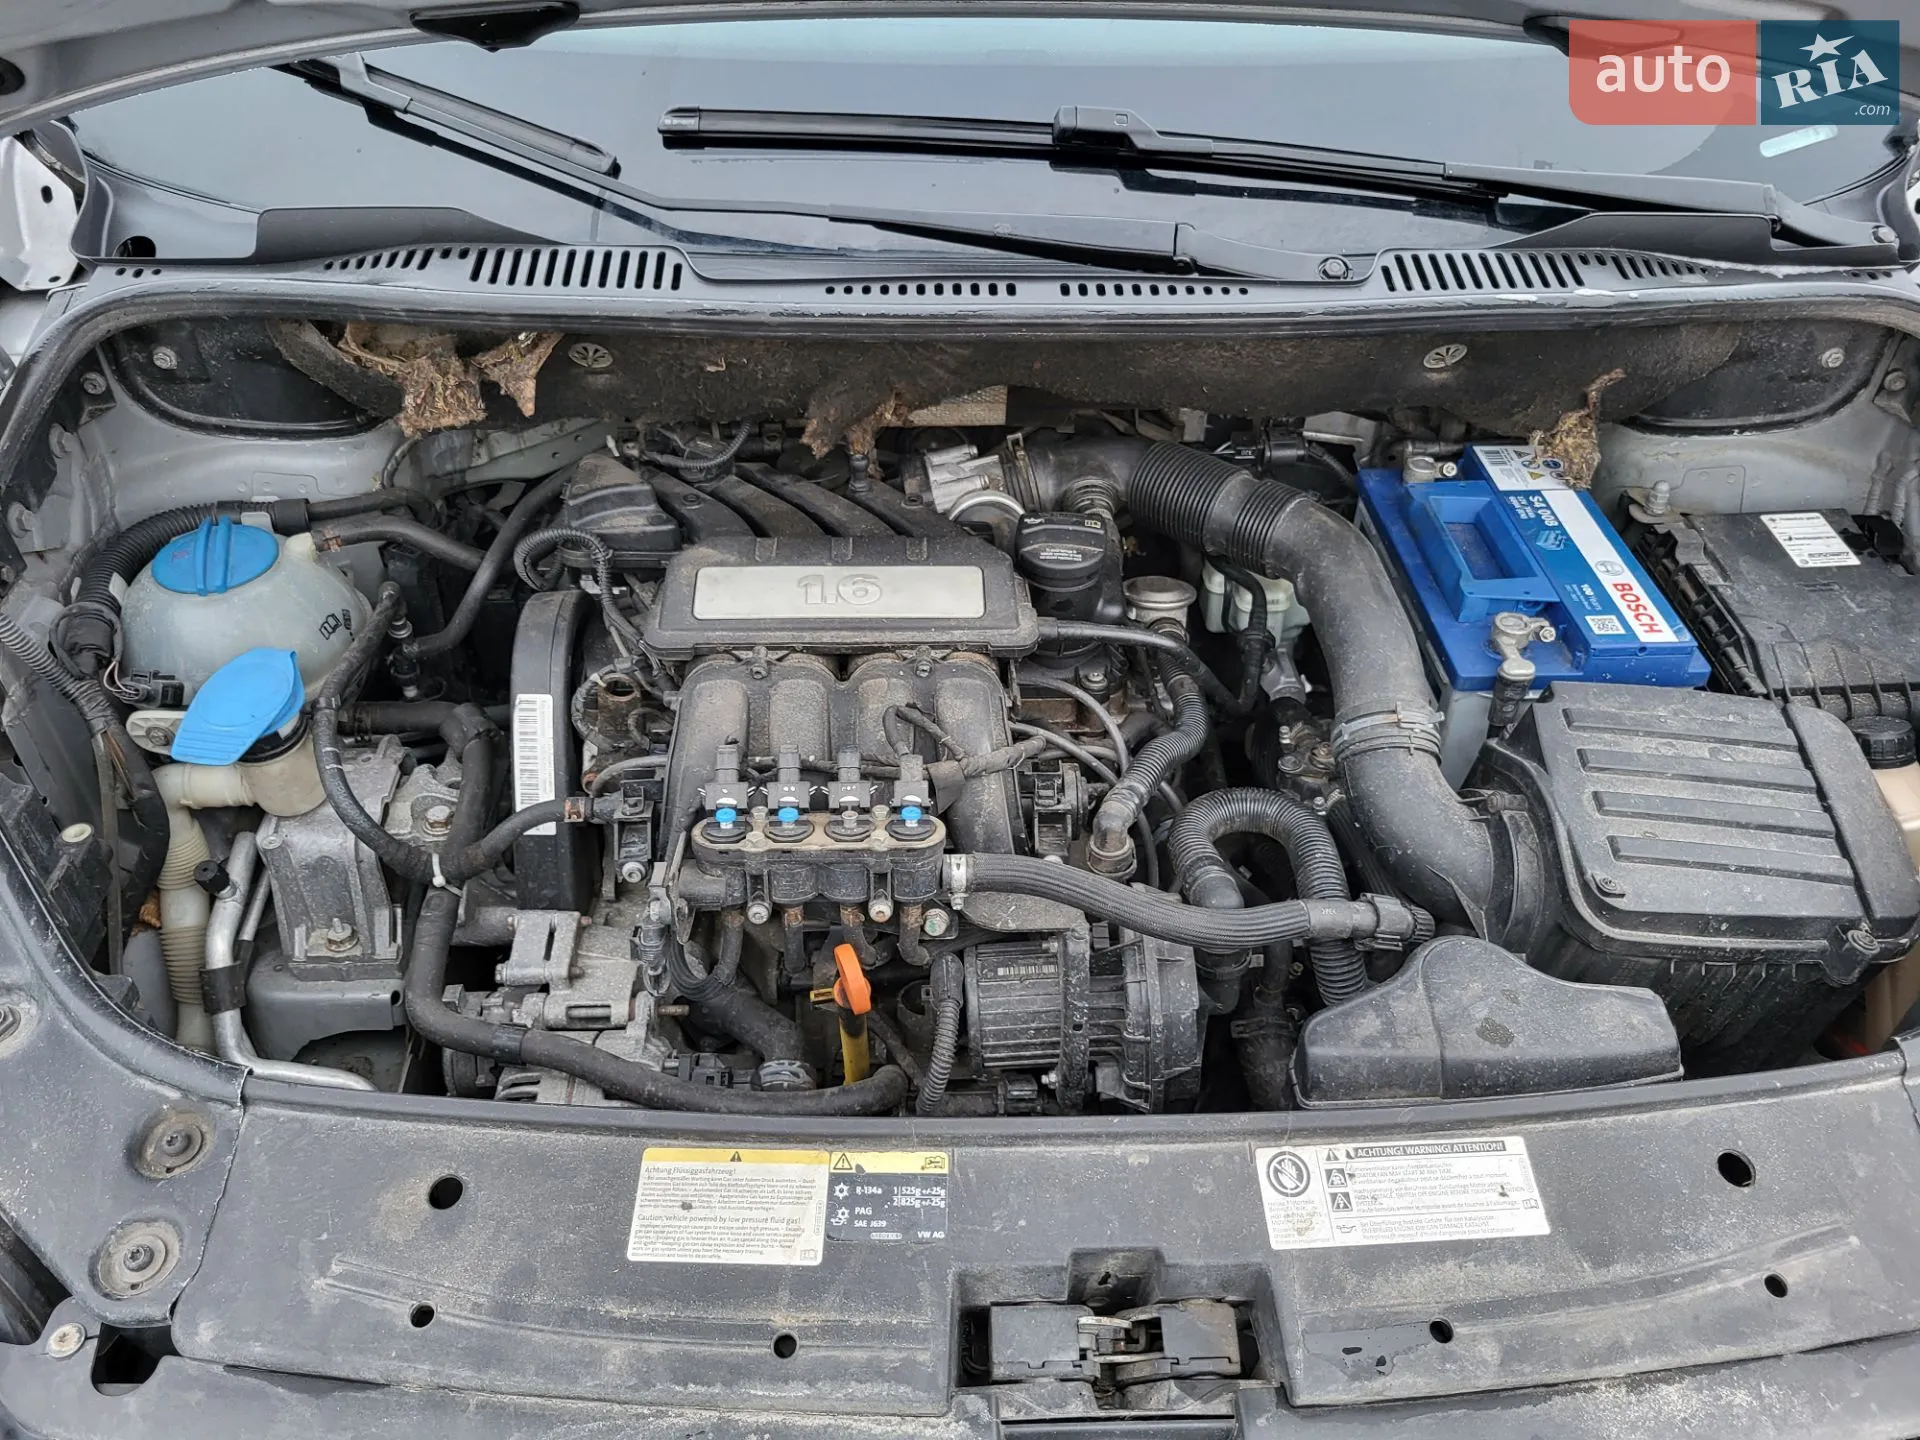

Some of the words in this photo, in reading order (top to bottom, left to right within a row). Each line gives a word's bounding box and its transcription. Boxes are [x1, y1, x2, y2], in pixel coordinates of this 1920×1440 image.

[1528, 495, 1547, 508] S4
[1538, 508, 1560, 527] 008
[797, 573, 884, 606] 1.6
[1612, 582, 1664, 634] BOSCH
[1357, 1146, 1405, 1157] ACHTUNG!
[1406, 1144, 1452, 1155] WARNING!
[1453, 1142, 1504, 1153] ATTENTION!
[855, 1186, 882, 1195] R-134a
[902, 1186, 921, 1196] 525g
[901, 1198, 920, 1208] 825g
[854, 1207, 873, 1215] PAG
[664, 1214, 688, 1222] vehicle
[689, 1215, 717, 1224] powered
[719, 1216, 727, 1225] by
[741, 1217, 768, 1225] pressure
[770, 1216, 785, 1224] fluid
[785, 1216, 801, 1226] gas!
[854, 1220, 868, 1228] SAE
[870, 1220, 887, 1228] J639
